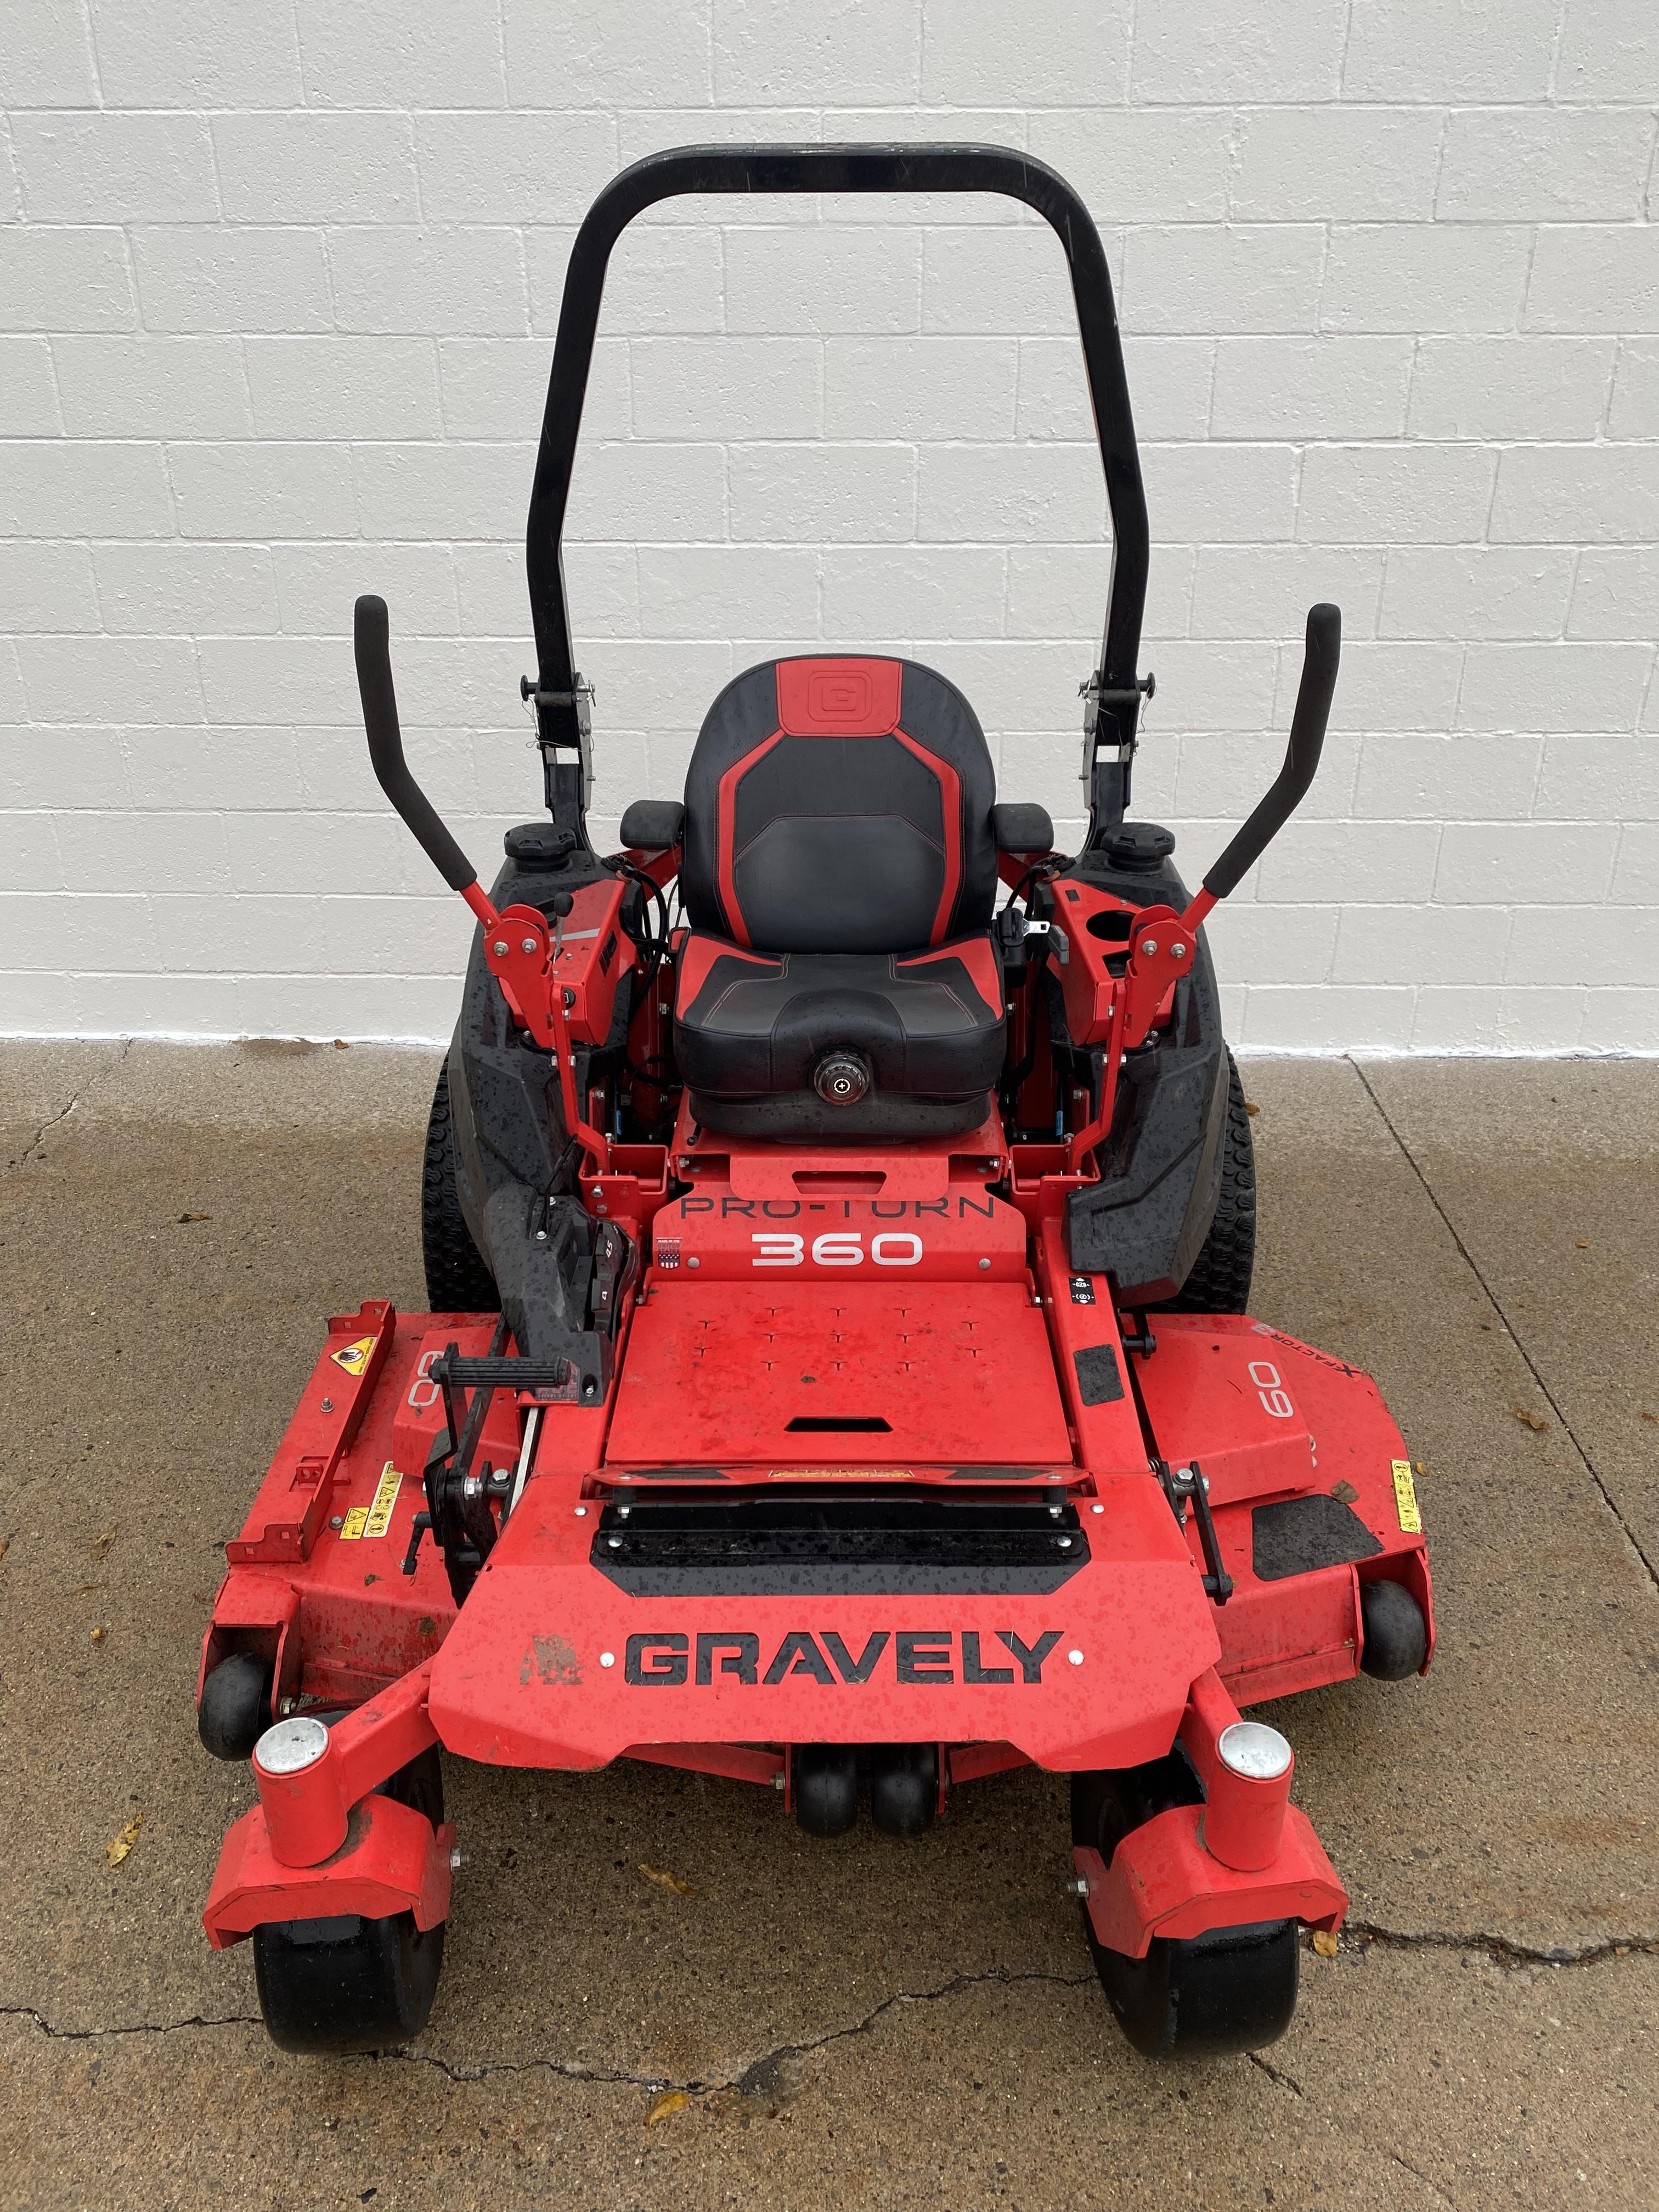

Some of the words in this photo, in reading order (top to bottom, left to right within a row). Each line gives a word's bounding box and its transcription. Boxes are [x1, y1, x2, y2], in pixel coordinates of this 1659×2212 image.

[752, 1233, 923, 1266] 360
[602, 1291, 608, 1300] 4
[1270, 1333, 1361, 1379] X-FACTOR
[1248, 1362, 1294, 1418] 60
[624, 1631, 1064, 1685] GRAVELY
